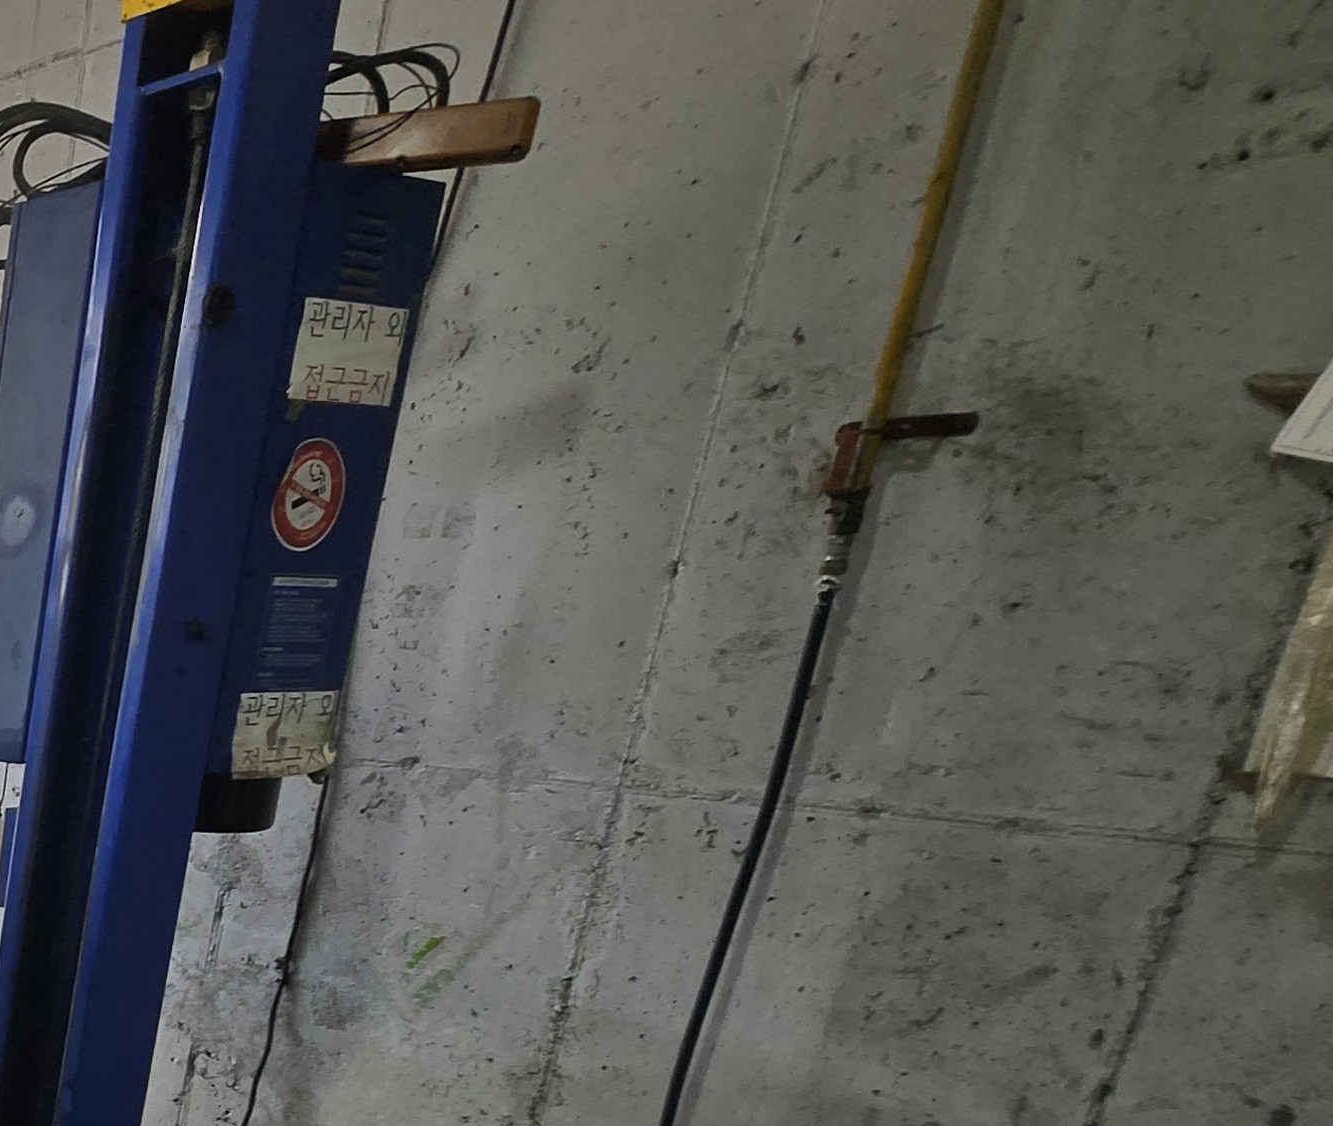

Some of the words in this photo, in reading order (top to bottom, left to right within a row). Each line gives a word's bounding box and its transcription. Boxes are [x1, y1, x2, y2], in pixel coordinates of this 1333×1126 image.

[308, 301, 375, 343] 관리자
[384, 310, 408, 347] 외
[304, 363, 391, 404] 접근금지
[242, 692, 307, 726] 관리자
